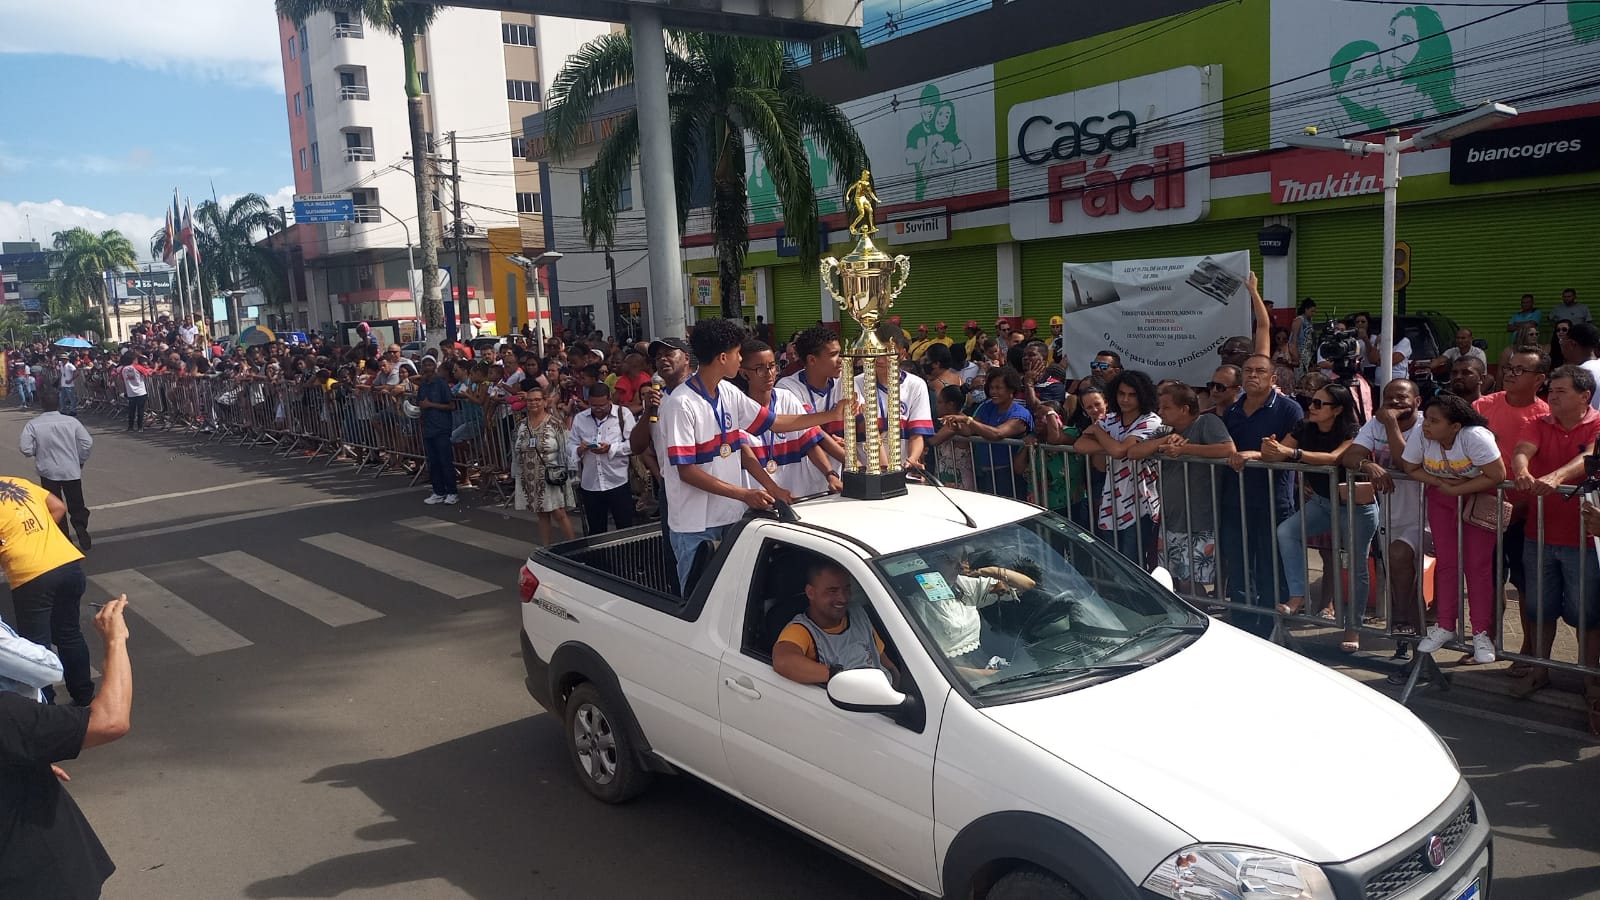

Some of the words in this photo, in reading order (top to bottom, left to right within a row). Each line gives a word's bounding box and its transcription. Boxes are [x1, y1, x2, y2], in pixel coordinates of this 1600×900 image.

[1018, 110, 1137, 165] Casa
[1467, 139, 1581, 163] biancogres
[1048, 142, 1185, 224] Fácil
[905, 218, 939, 234] Suvinil
[1103, 332, 1111, 341] O
[1109, 340, 1124, 353] piso
[1130, 353, 1145, 364] para
[1146, 358, 1167, 367] todos
[21, 518, 35, 531] ZIP
